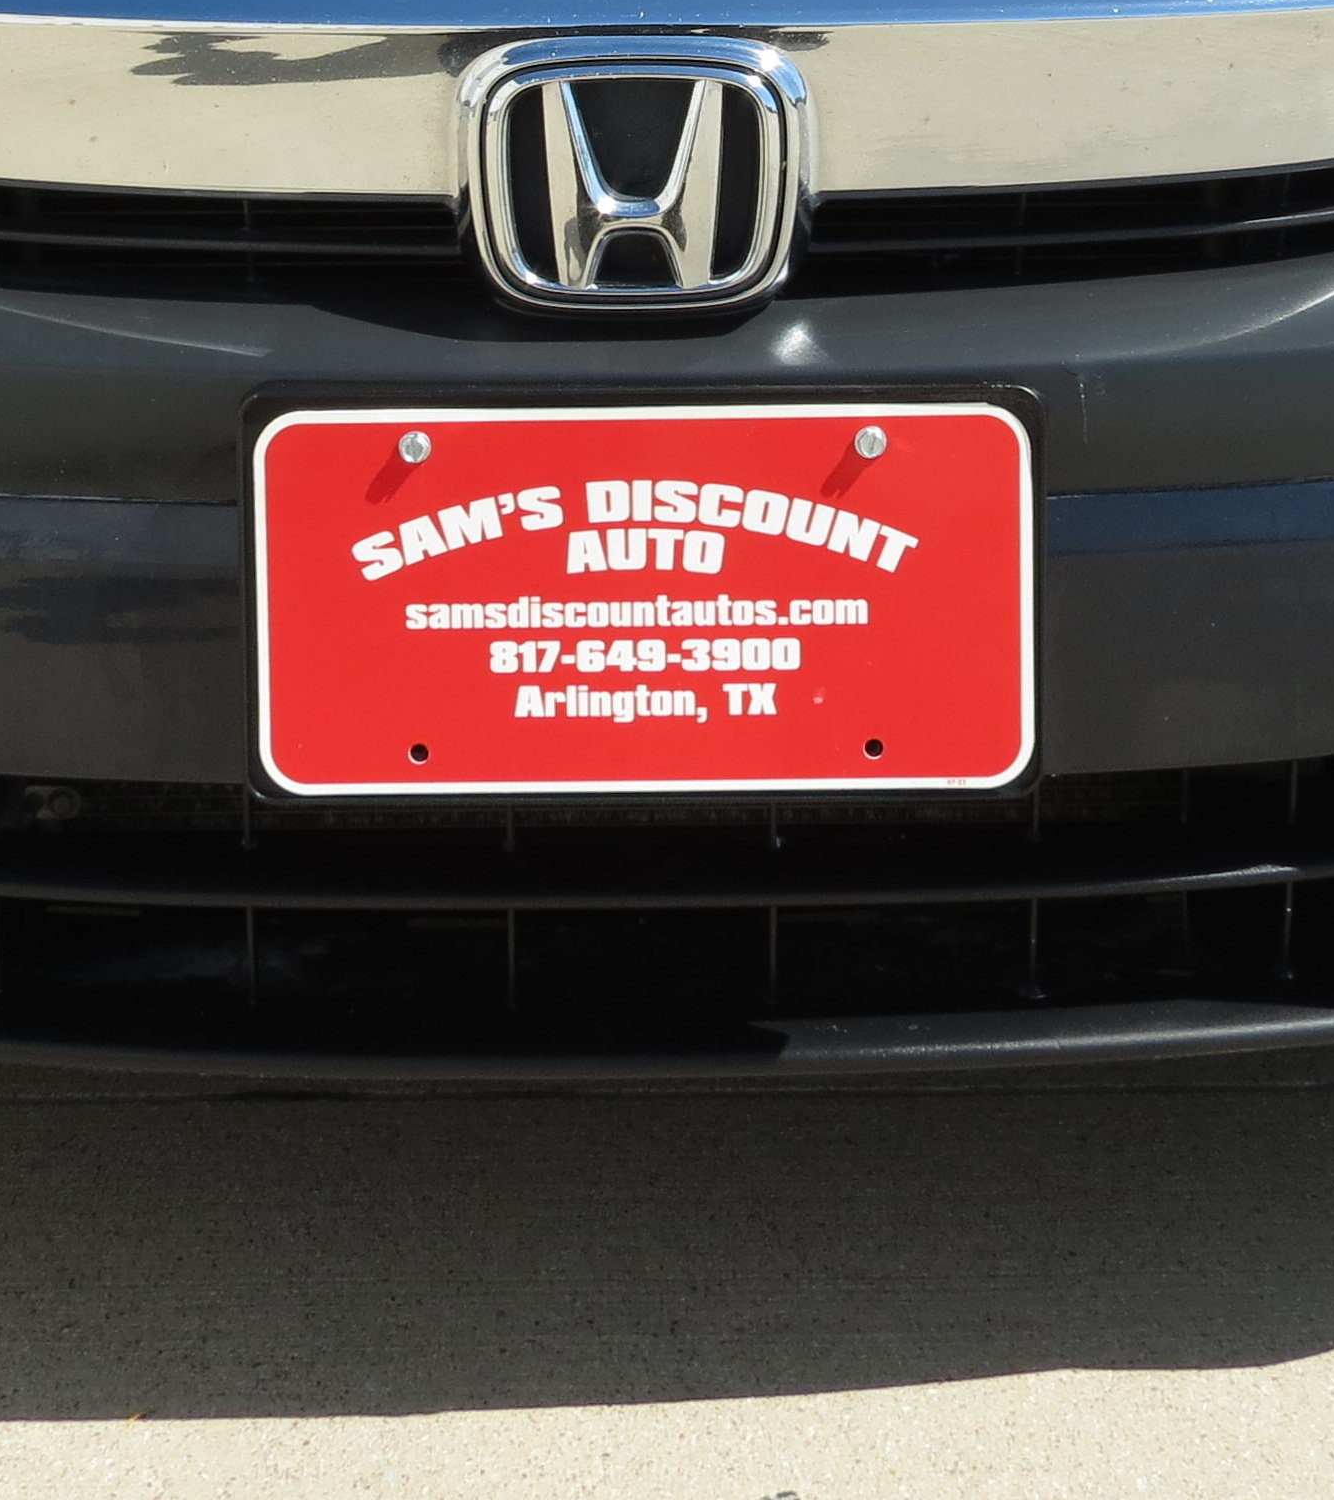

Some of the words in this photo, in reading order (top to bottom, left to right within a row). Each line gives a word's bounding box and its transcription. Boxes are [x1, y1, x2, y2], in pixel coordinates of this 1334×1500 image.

[351, 484, 564, 581] SAM'S
[585, 479, 919, 573] DISCOUNT
[566, 527, 726, 575] AUTO
[404, 593, 869, 630] samsdiscountautos.com
[488, 637, 802, 674] 817-649-3900
[513, 684, 708, 724] Arlington,
[721, 682, 777, 716] TX
